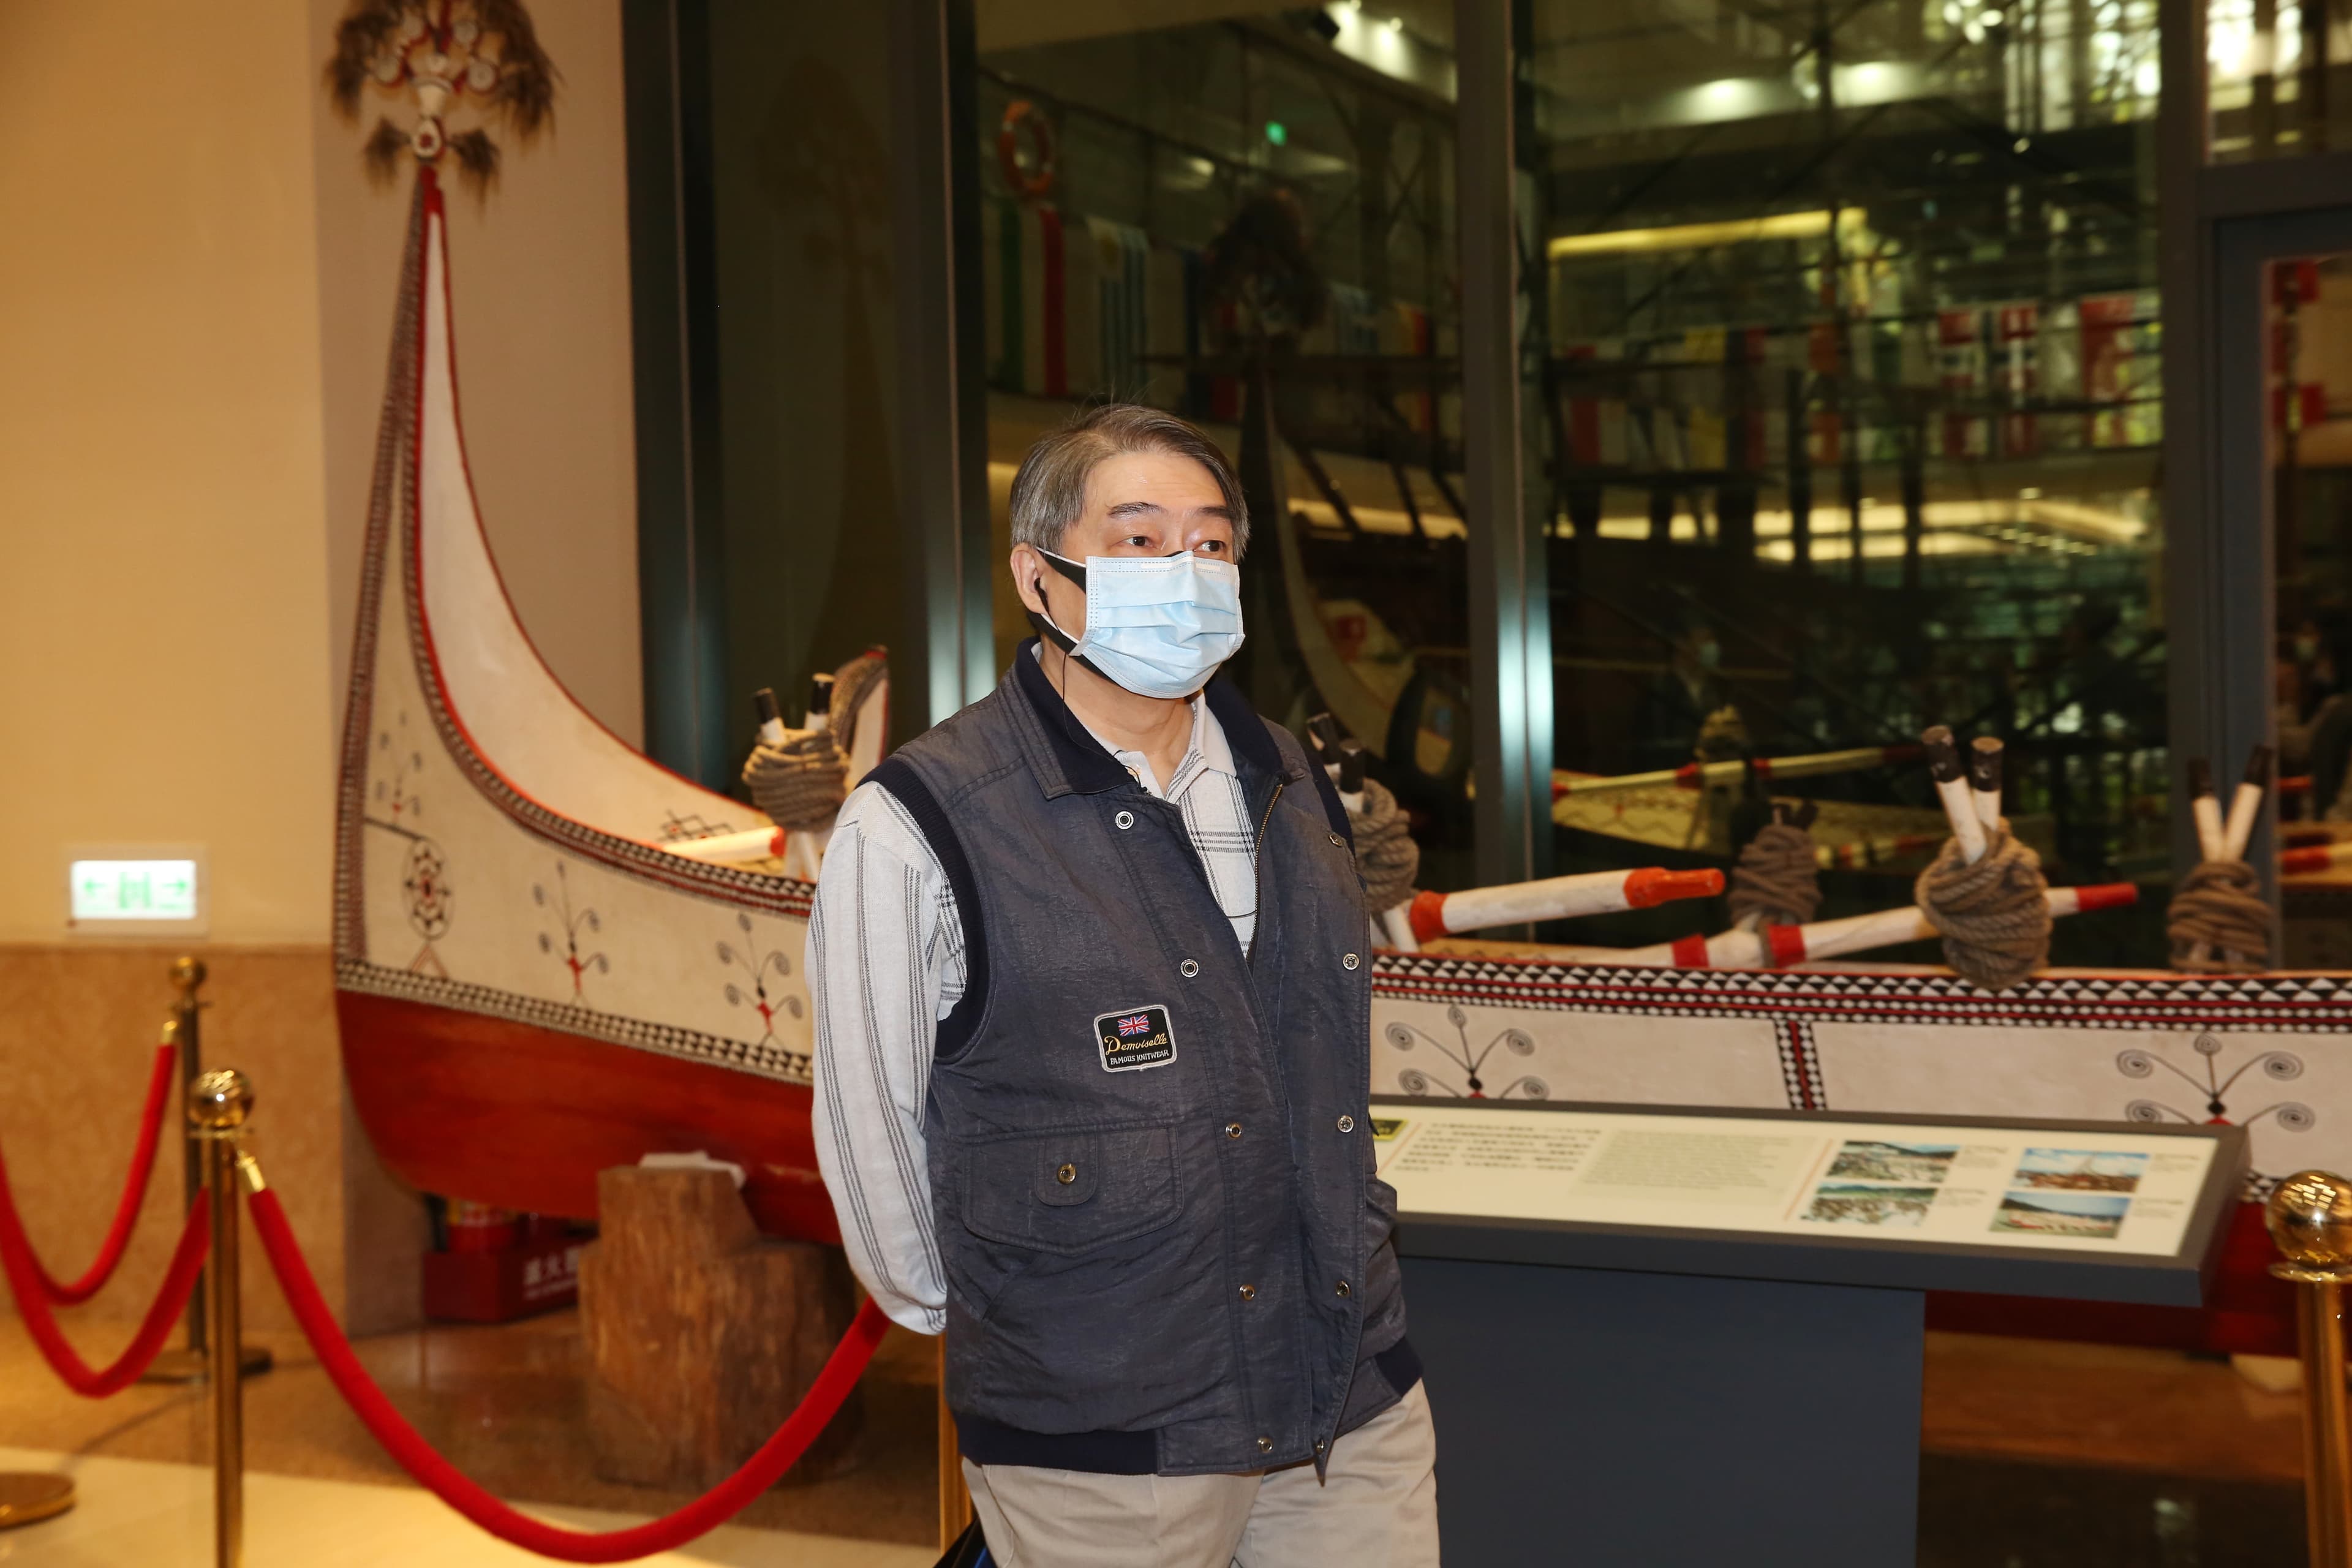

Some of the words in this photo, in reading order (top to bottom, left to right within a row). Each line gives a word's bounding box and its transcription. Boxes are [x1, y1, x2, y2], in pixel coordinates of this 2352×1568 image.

[1104, 1033, 1168, 1055] Demoiselle
[1110, 1055, 1136, 1065] FAMOUS
[1136, 1049, 1169, 1062] KNITWEAR
